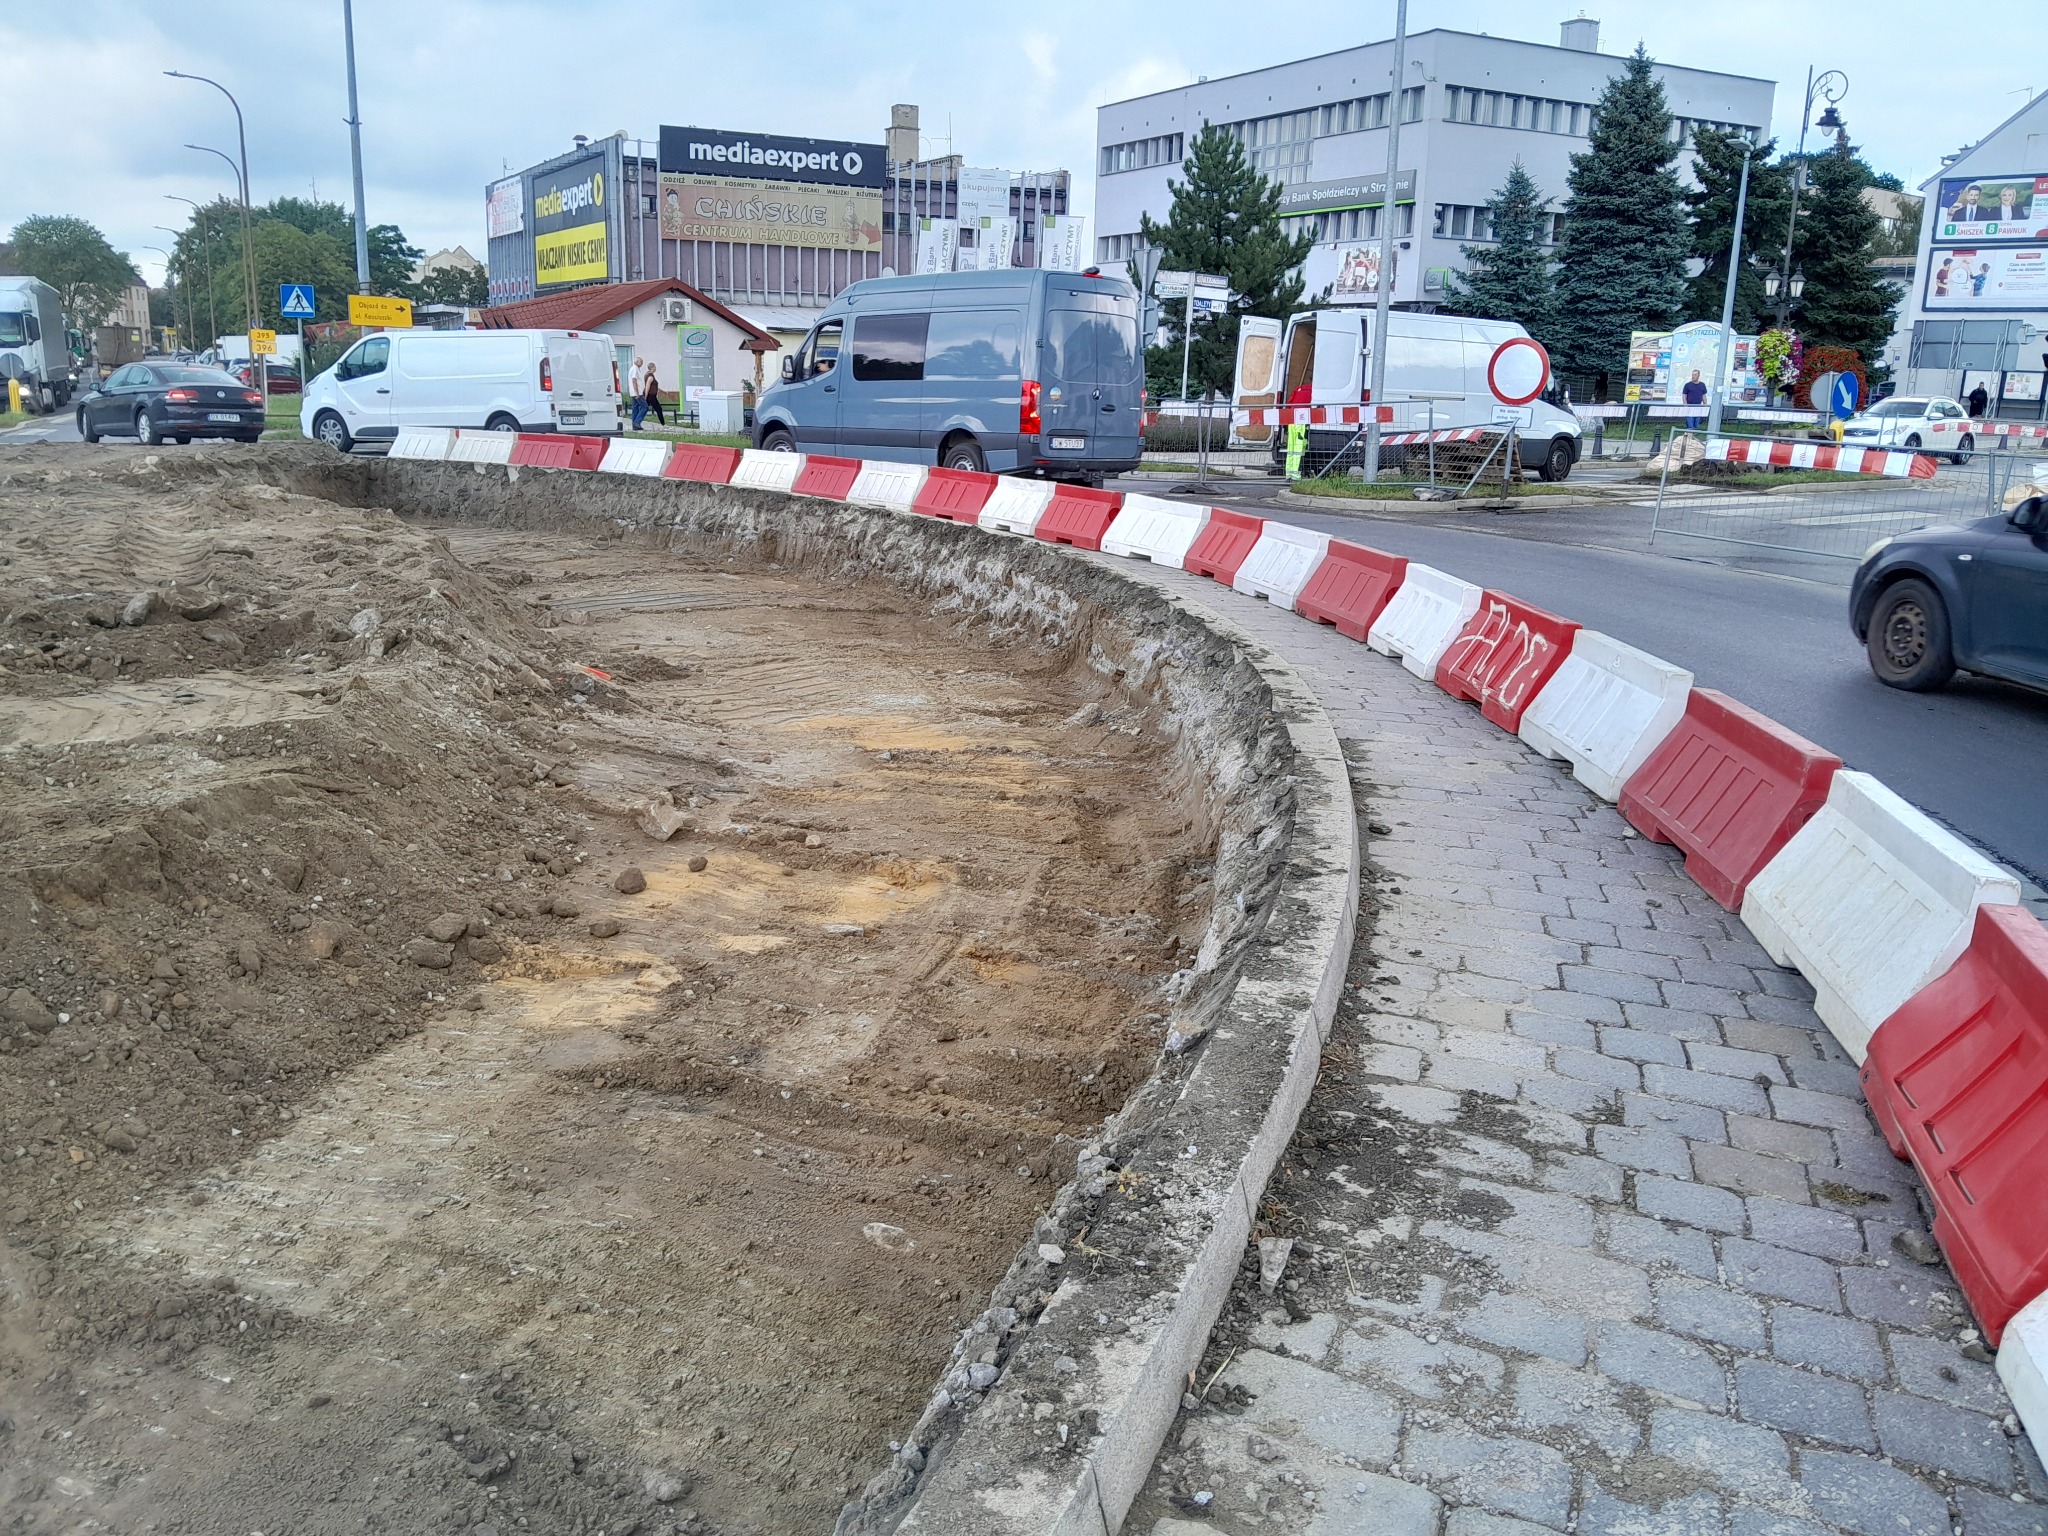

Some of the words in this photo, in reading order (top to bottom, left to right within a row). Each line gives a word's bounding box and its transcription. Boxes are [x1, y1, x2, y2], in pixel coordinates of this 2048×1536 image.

[689, 140, 839, 172] mediaexpert
[536, 176, 593, 218] mediaexpert
[663, 176, 686, 184] ODZIEŻ
[693, 178, 717, 186] OBUWIE
[826, 188, 850, 196] WALIZKI
[856, 190, 883, 198] BIŻUTERIA
[962, 182, 1007, 194] skupujemy
[1292, 189, 1310, 202] Bank
[1312, 185, 1359, 201] Spółdzielczy
[1362, 185, 1369, 194] w
[1370, 180, 1409, 193] Strznie
[694, 194, 827, 226] CHIŃSKIE
[683, 224, 752, 239] CENTRUM
[759, 228, 839, 245] HANDLOWE
[1948, 225, 1952, 234] 1
[1956, 227, 1984, 235] ŚMISZEK
[1989, 225, 1994, 233] 8
[538, 244, 566, 271] WŁĄCZAMY
[568, 241, 586, 267] NISKIE
[587, 238, 605, 263] CENY!
[1194, 300, 1211, 308] TOALETY
